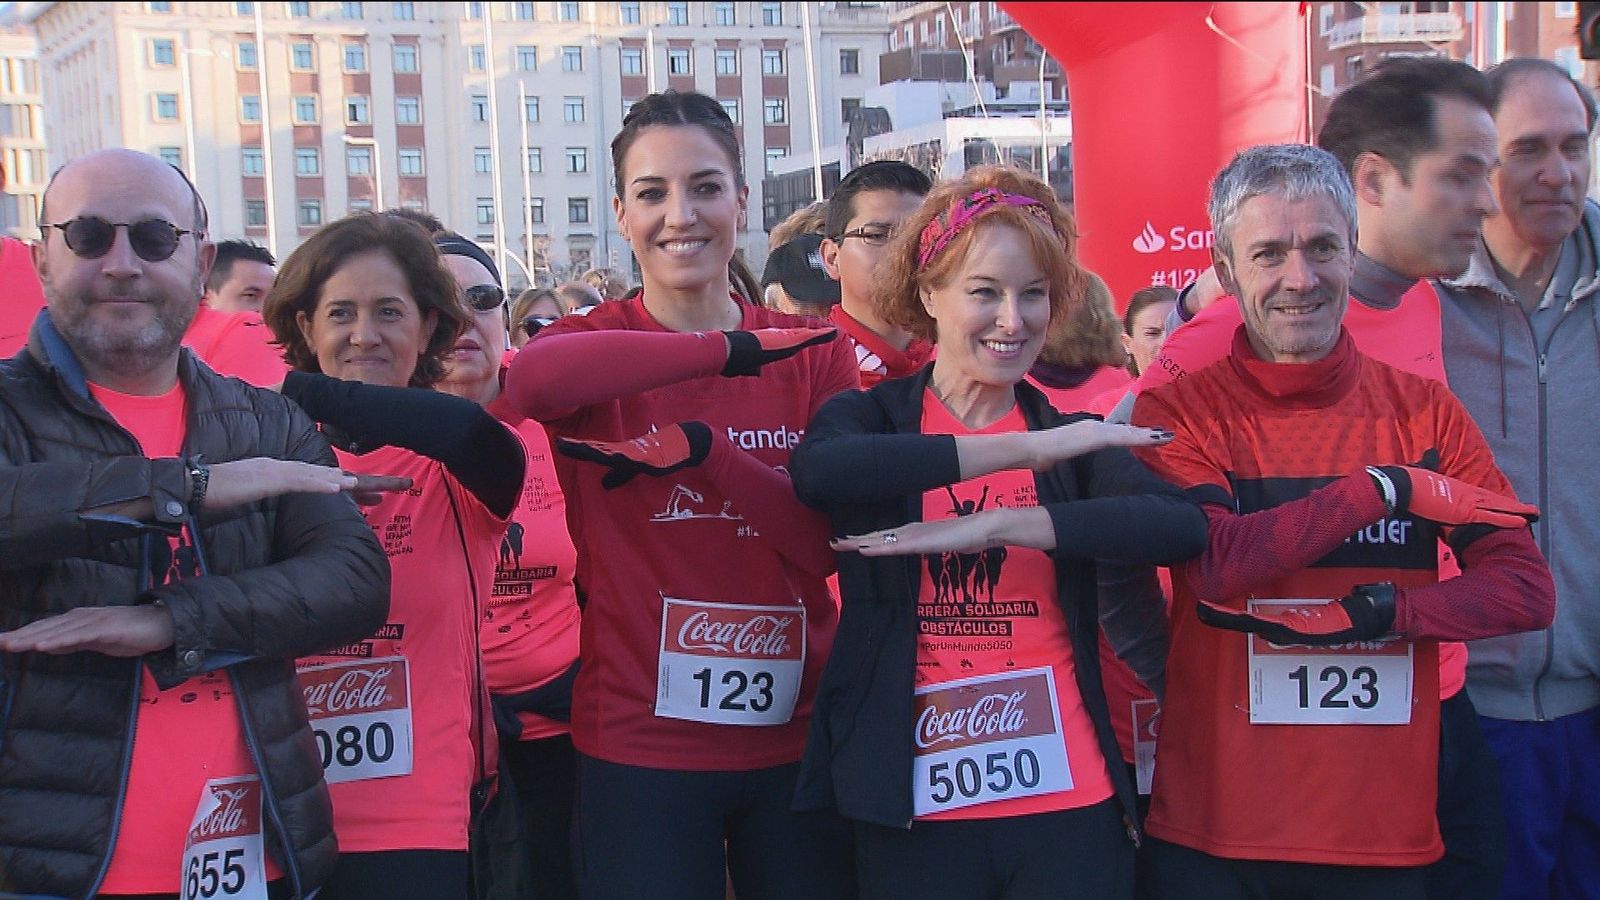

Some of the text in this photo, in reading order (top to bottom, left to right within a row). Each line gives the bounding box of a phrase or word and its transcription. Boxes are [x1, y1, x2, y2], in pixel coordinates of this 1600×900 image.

[727, 425, 805, 450] tande
[920, 621, 1007, 635] OBSTÁCULOS
[965, 602, 1035, 616] SOLIDARIA
[677, 611, 793, 655] Coca-Cola
[693, 667, 774, 712] 123
[1288, 665, 1379, 709] 123
[915, 690, 1027, 748] Coca-Cola
[929, 749, 1040, 803] 5050
